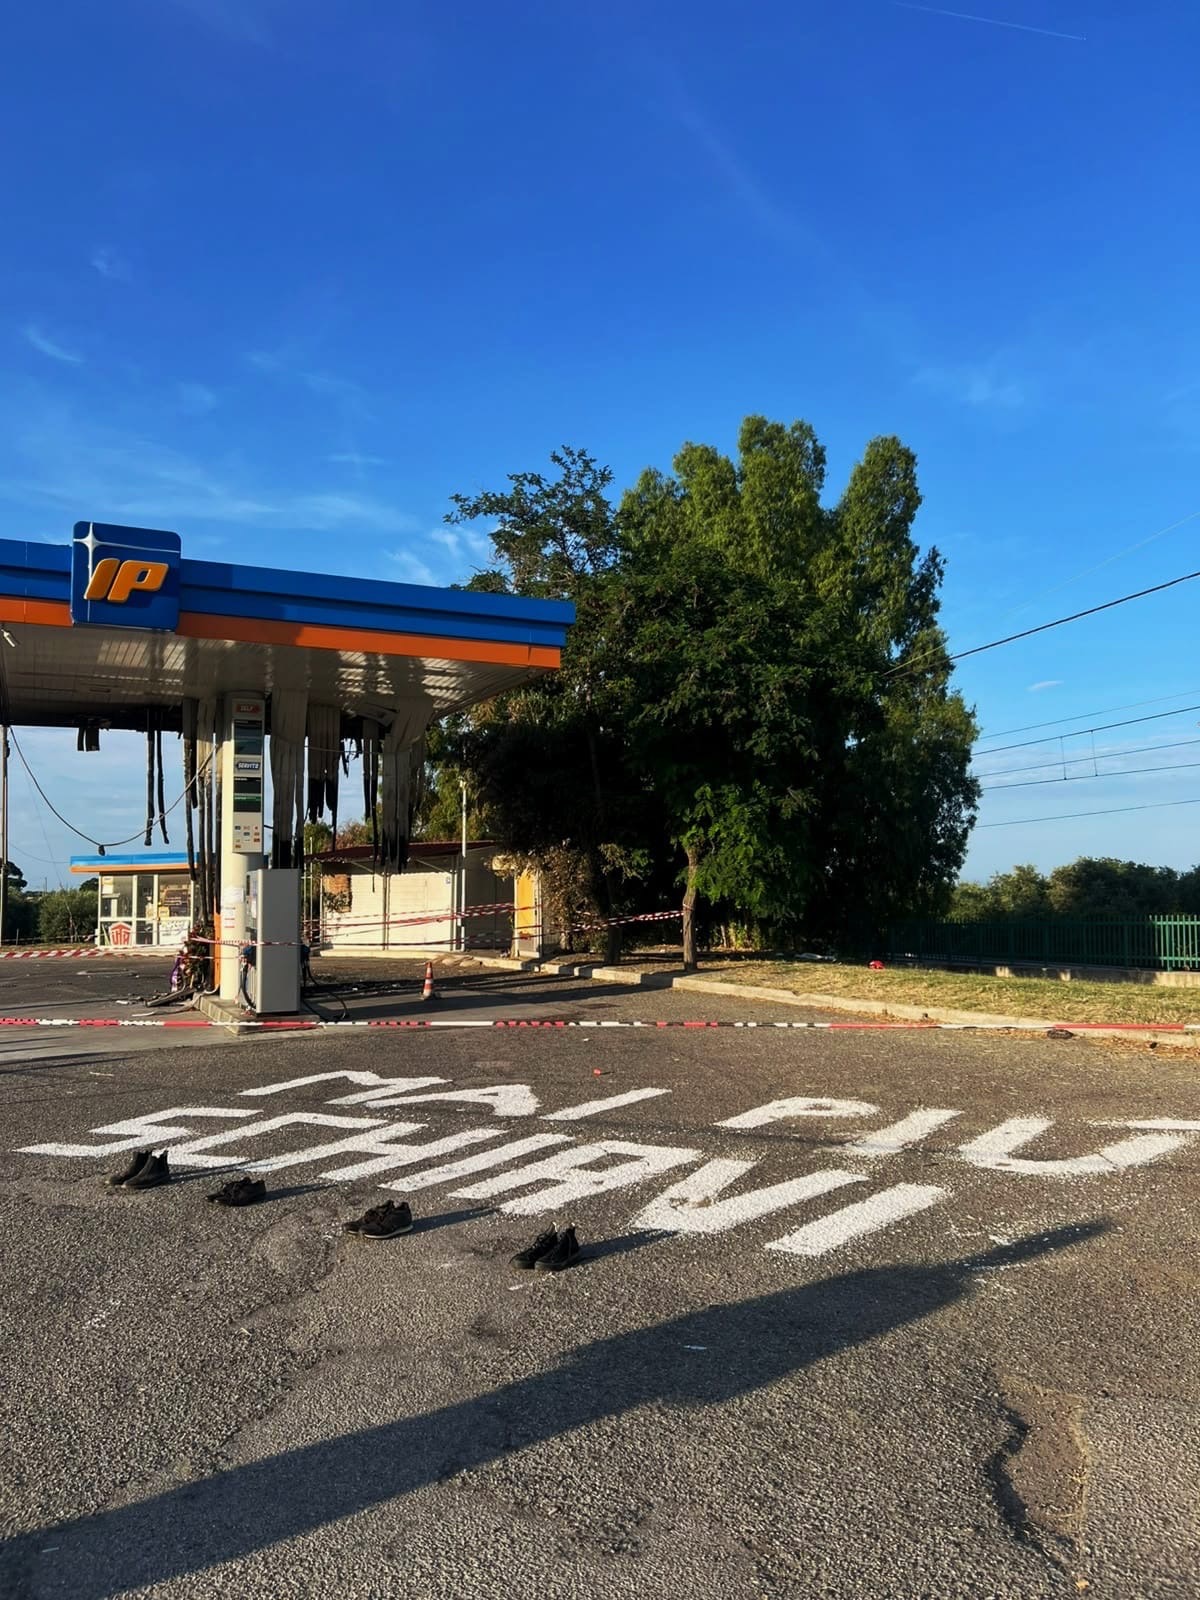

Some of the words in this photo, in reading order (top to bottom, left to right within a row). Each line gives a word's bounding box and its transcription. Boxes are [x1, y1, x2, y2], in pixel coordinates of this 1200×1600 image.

[83, 557, 169, 604] IP
[237, 1070, 671, 1121] MAI
[11, 1106, 949, 1257] SCHIAVI
